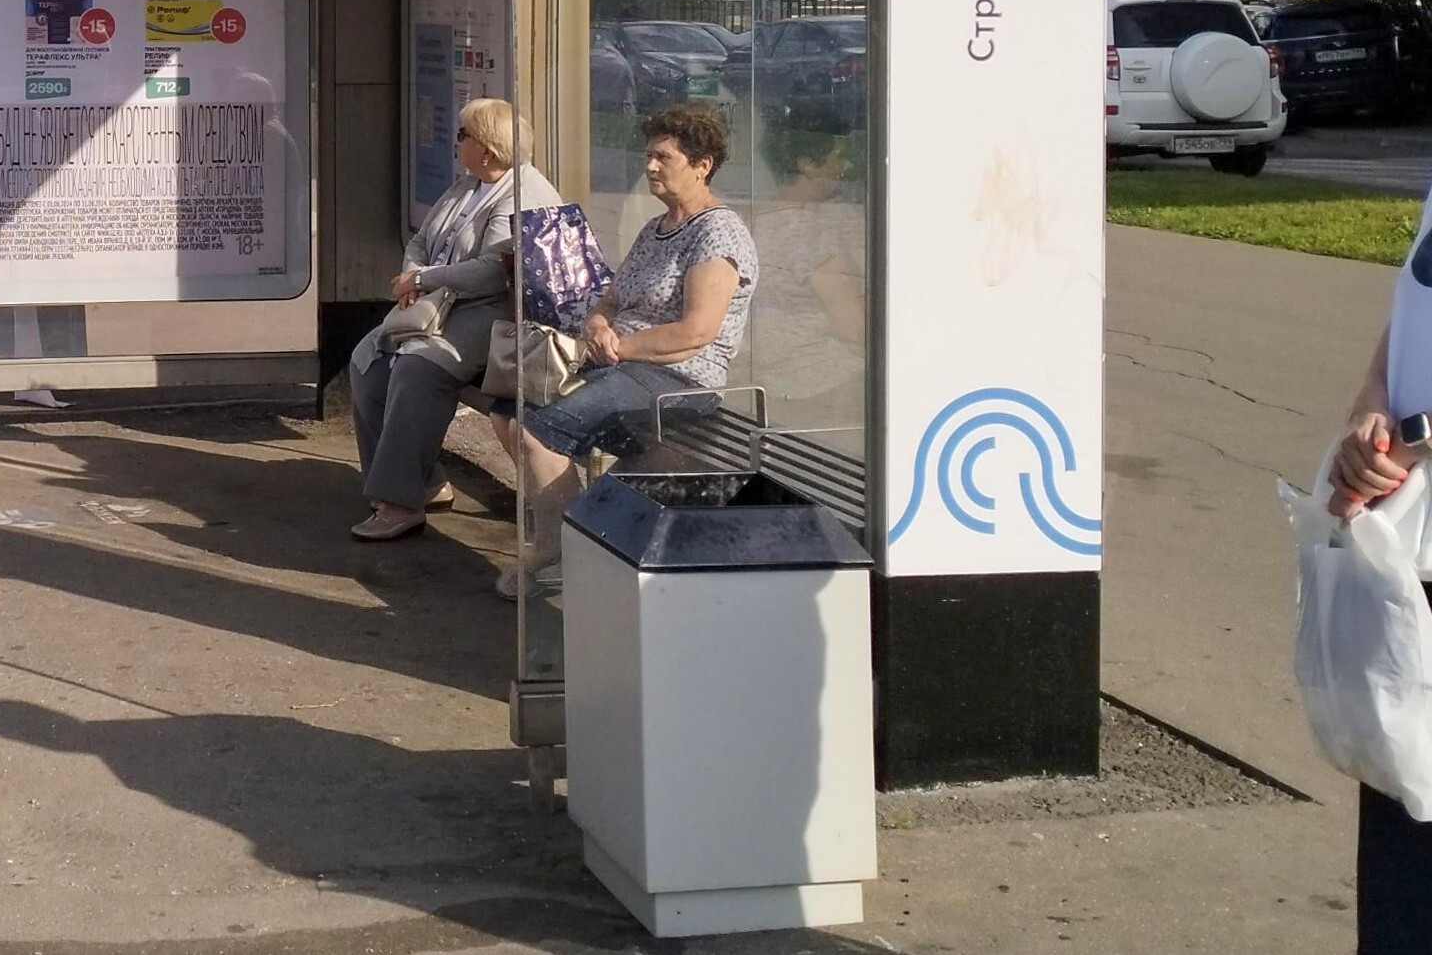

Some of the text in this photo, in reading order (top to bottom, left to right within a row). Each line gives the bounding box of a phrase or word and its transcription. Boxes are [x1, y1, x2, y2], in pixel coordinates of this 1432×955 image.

[24, 107, 37, 165] НЕ
[39, 106, 95, 165] ЯВЛЯЕТСЯ
[97, 105, 195, 165] ЛЕКАРСТВЕННЫМ
[197, 104, 264, 165] СРЕДСТВОМ
[236, 235, 265, 255] 18+
